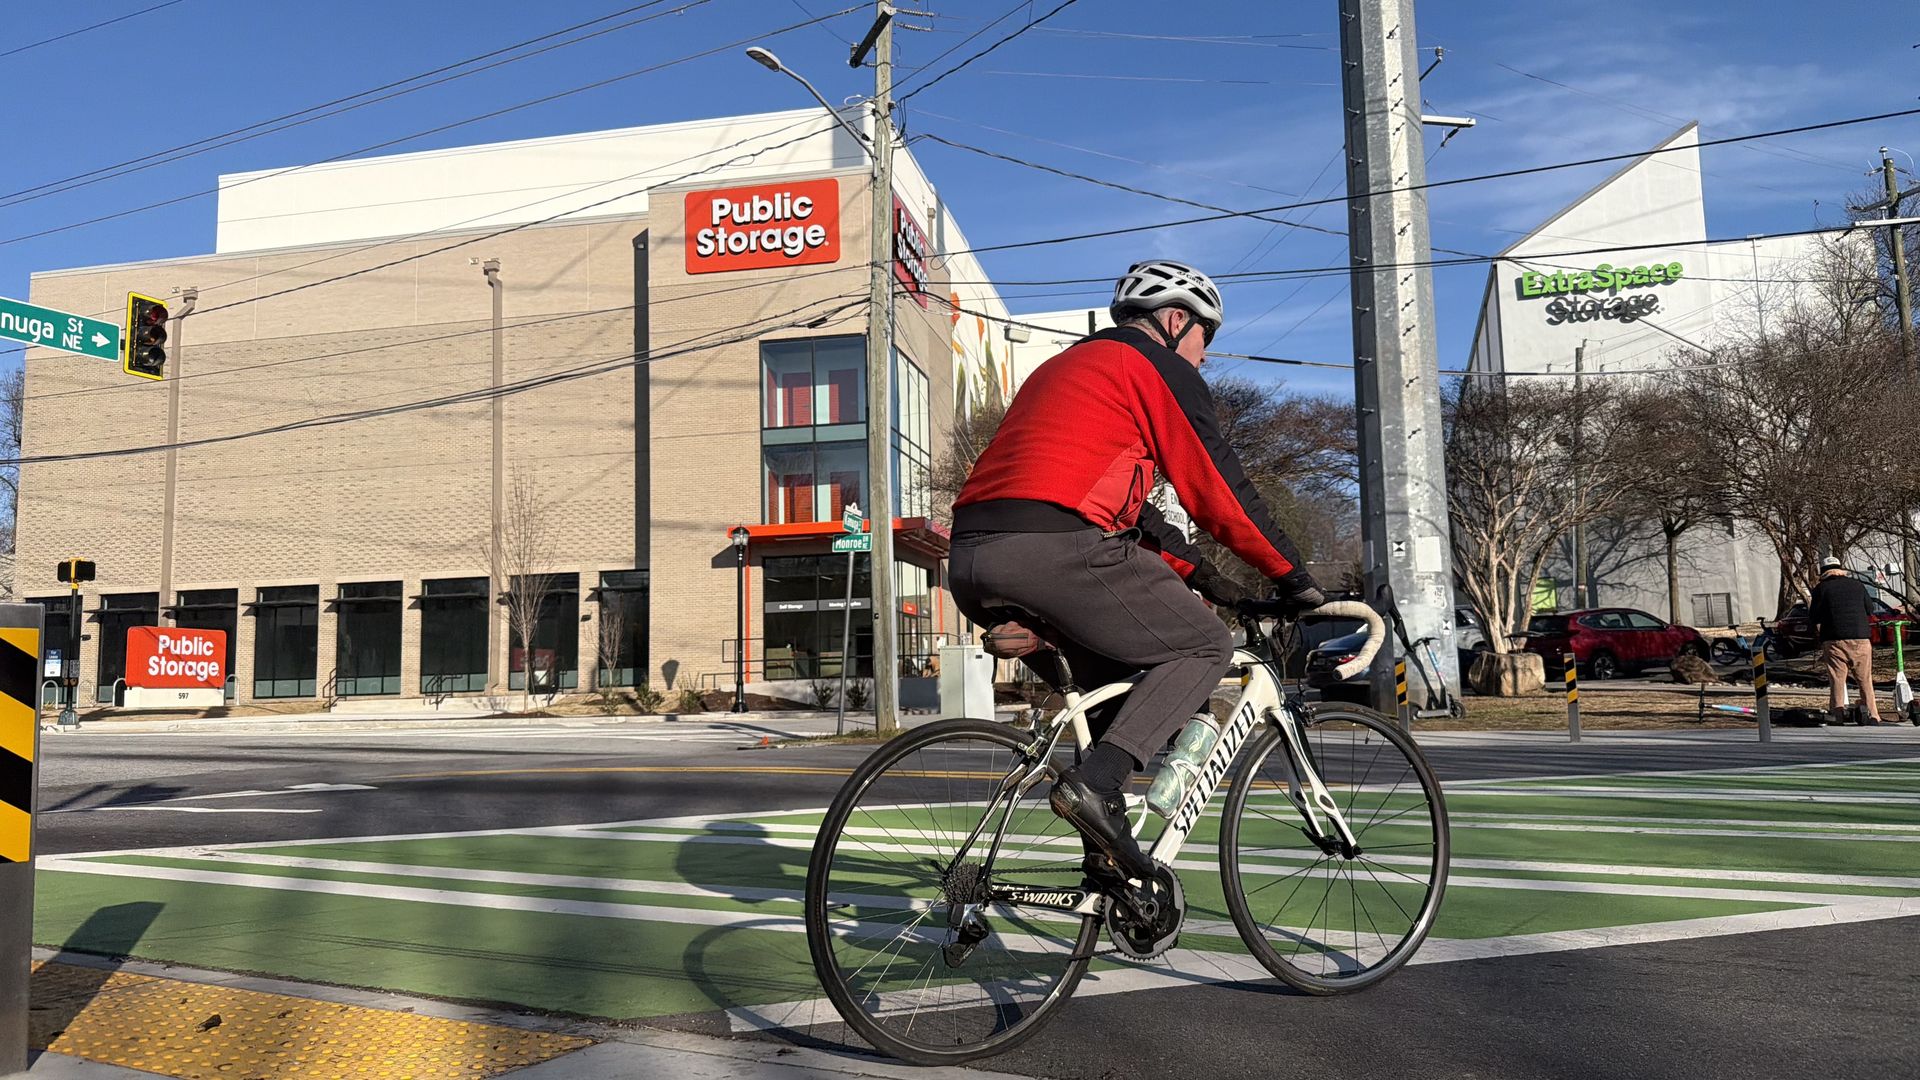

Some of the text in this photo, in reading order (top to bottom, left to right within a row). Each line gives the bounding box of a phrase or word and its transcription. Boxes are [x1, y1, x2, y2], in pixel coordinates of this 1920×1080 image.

[711, 192, 813, 226] Public
[697, 224, 827, 256] Storage
[900, 208, 925, 262] Public
[898, 232, 928, 293] Storage
[1522, 262, 1684, 296] ExtraSpace
[1547, 293, 1660, 322] Storage
[1, 312, 84, 342] nuga St
[62, 333, 83, 350] NE
[1167, 510, 1186, 524] SCHOOL
[835, 537, 862, 549] Monroe
[158, 635, 214, 657] Public
[148, 656, 219, 681] Storage
[1174, 701, 1256, 837] SPECIALIZED
[1008, 891, 1077, 907] S-WORKS
